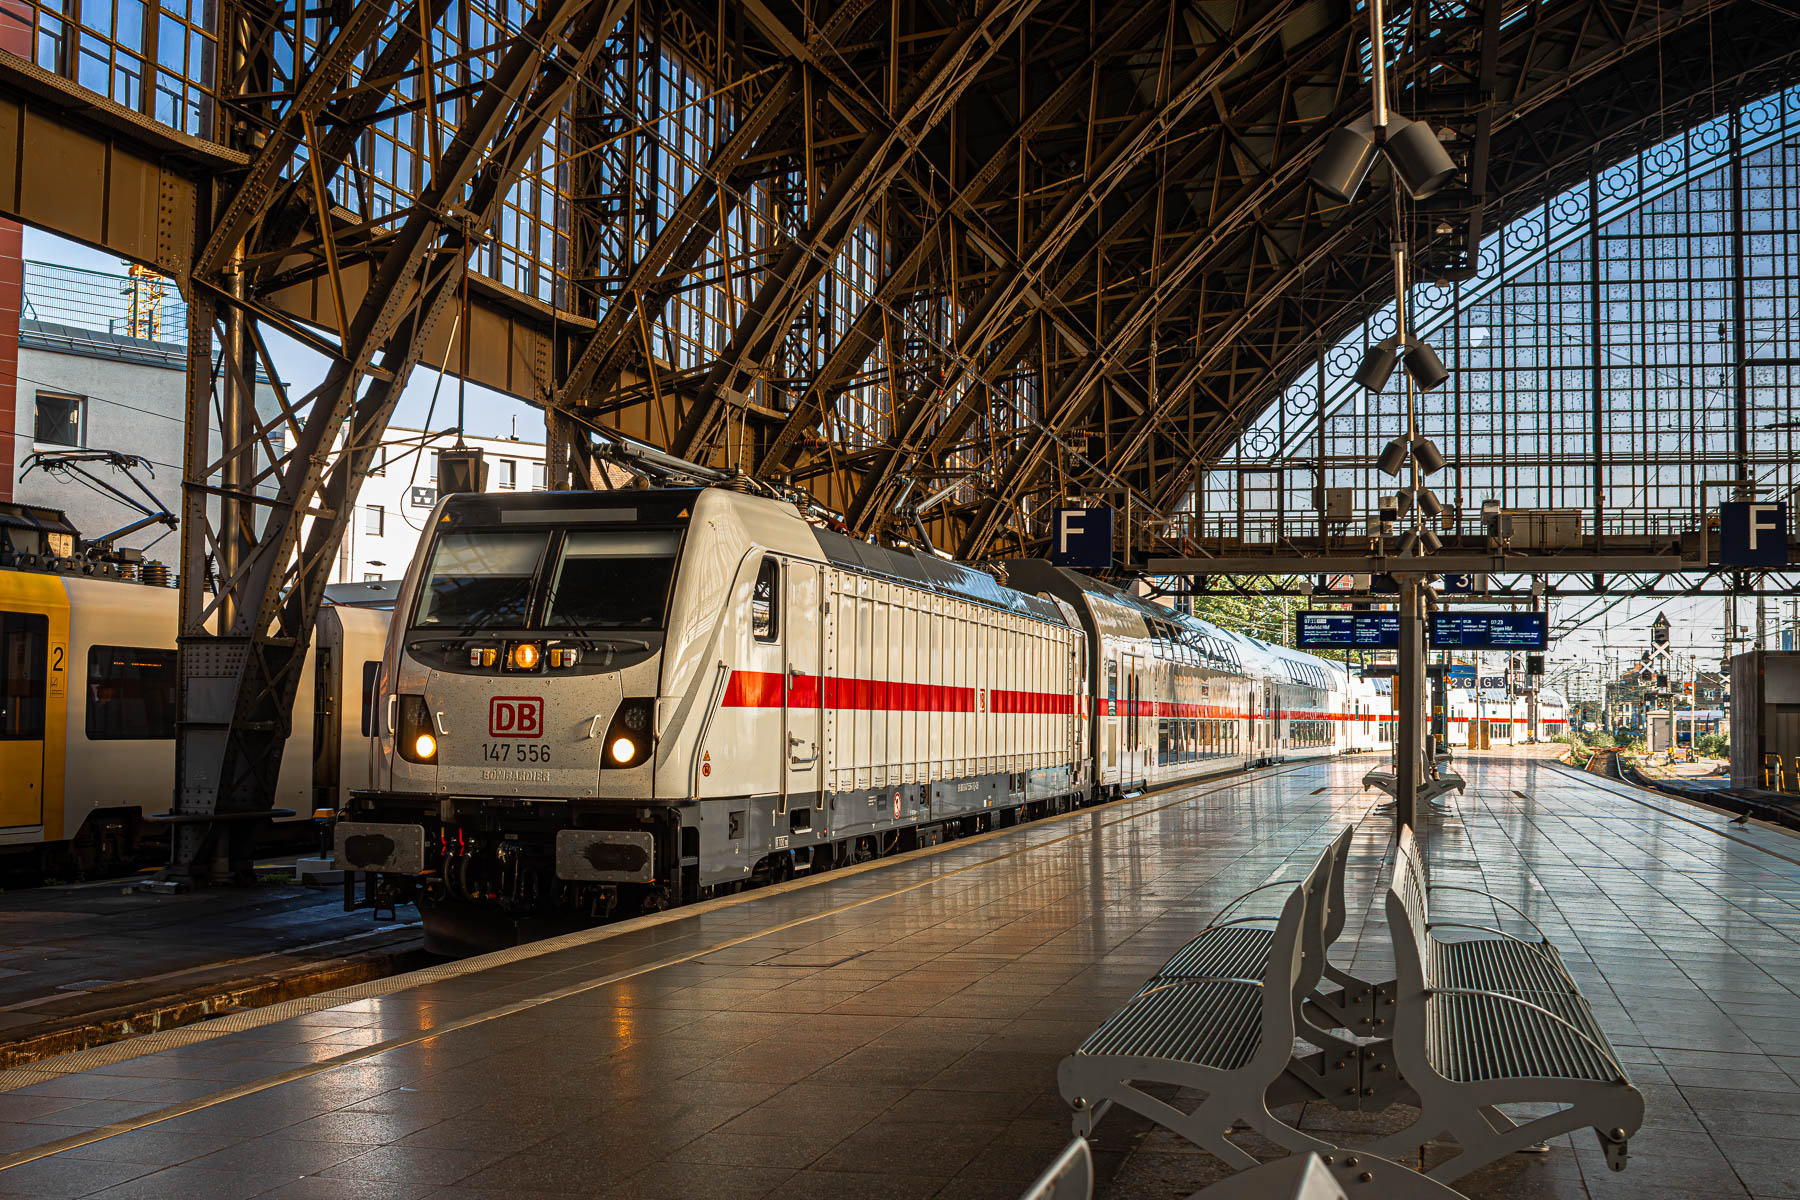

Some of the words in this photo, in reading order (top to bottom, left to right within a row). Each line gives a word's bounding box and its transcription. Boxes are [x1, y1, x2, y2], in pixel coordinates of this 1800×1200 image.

[1060, 510, 1086, 553] F
[1749, 504, 1778, 550] F
[1456, 573, 1470, 588] 3
[53, 646, 64, 672] 2
[1451, 677, 1458, 688] 2
[1463, 677, 1472, 688] G
[1483, 677, 1492, 688] G
[1497, 677, 1505, 687] 3
[495, 702, 538, 732] DB
[482, 743, 511, 762] 147
[516, 744, 551, 763] 556
[482, 770, 550, 782] BOMBARDIER
